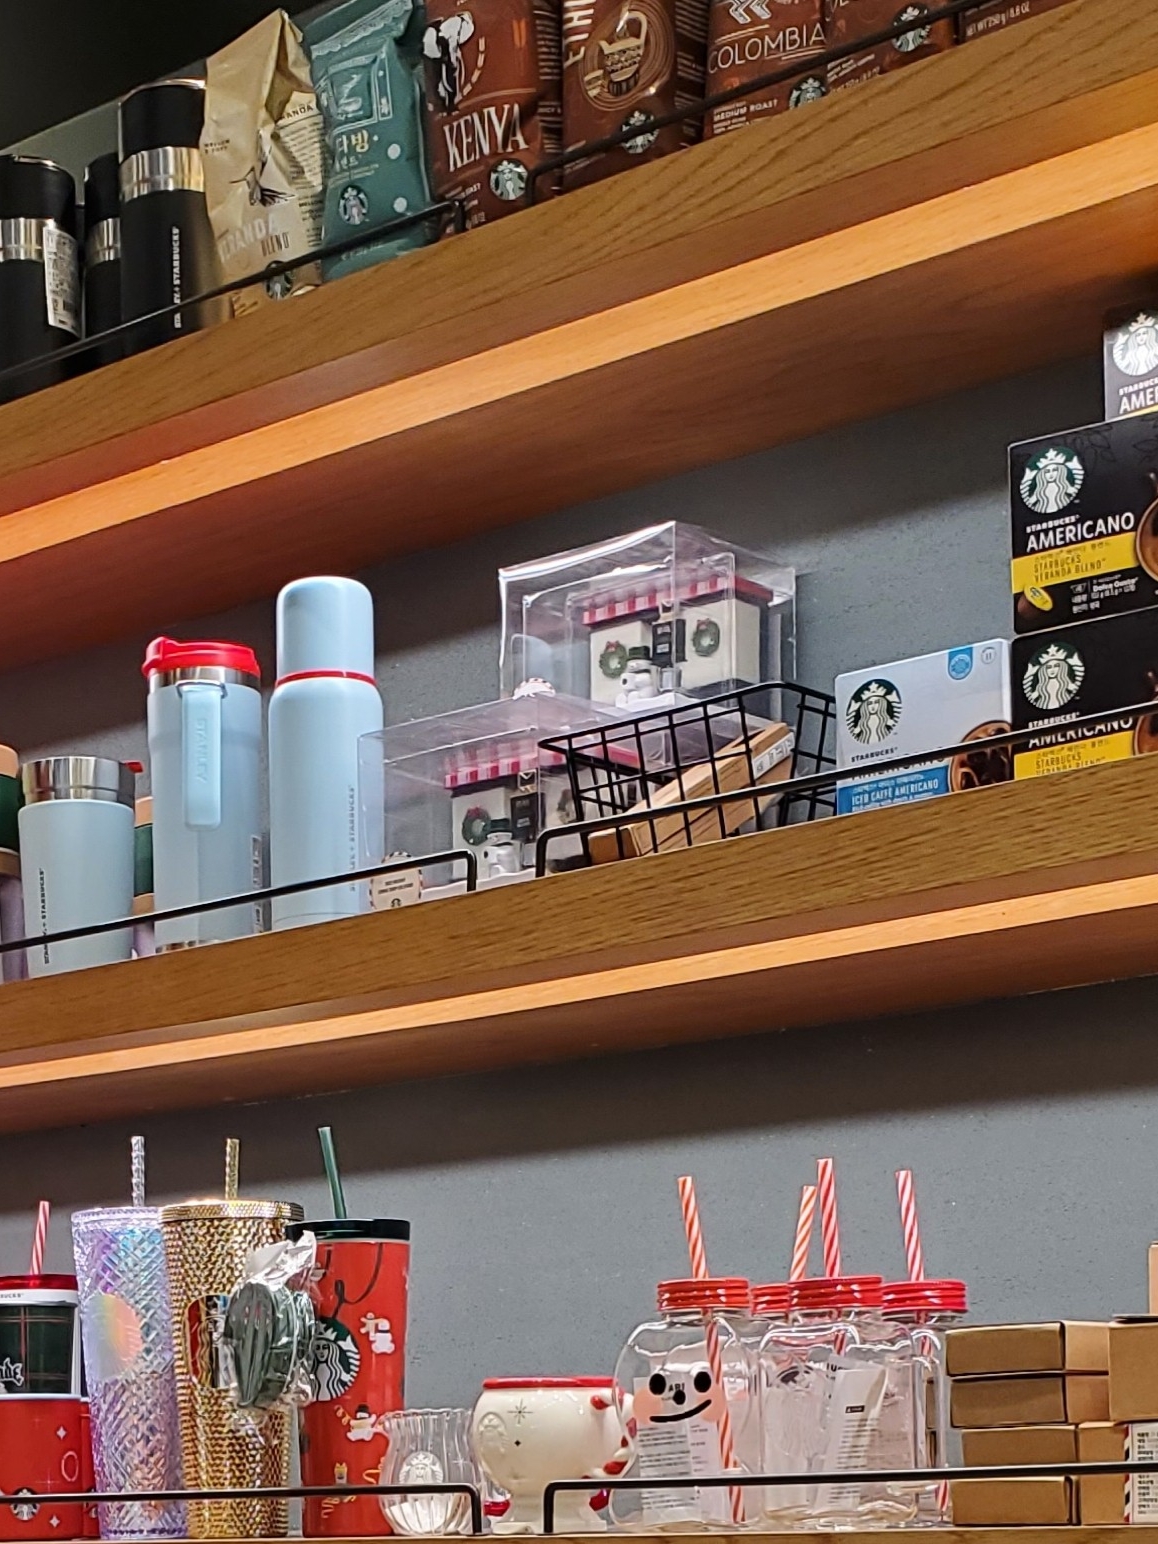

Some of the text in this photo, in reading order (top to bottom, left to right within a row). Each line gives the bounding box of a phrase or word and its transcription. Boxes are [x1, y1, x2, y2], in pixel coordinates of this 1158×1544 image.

[708, 23, 826, 74] COLOMBIA
[713, 106, 747, 122] MEDIUM
[748, 98, 779, 112] ROAST
[443, 103, 529, 172] KENYA
[261, 233, 290, 257] BLEND
[1025, 514, 1076, 534] STARBUCKS
[1026, 511, 1135, 553] AMERICANO
[1034, 554, 1082, 574] STARBUCKS
[1035, 564, 1073, 583] VERANDA
[1074, 558, 1101, 575] BLEND
[1028, 712, 1077, 729] STARBUCKS
[850, 747, 895, 763] STARBUCKS
[1035, 752, 1082, 770] STARBUCKS
[893, 777, 939, 797] AMERICANO
